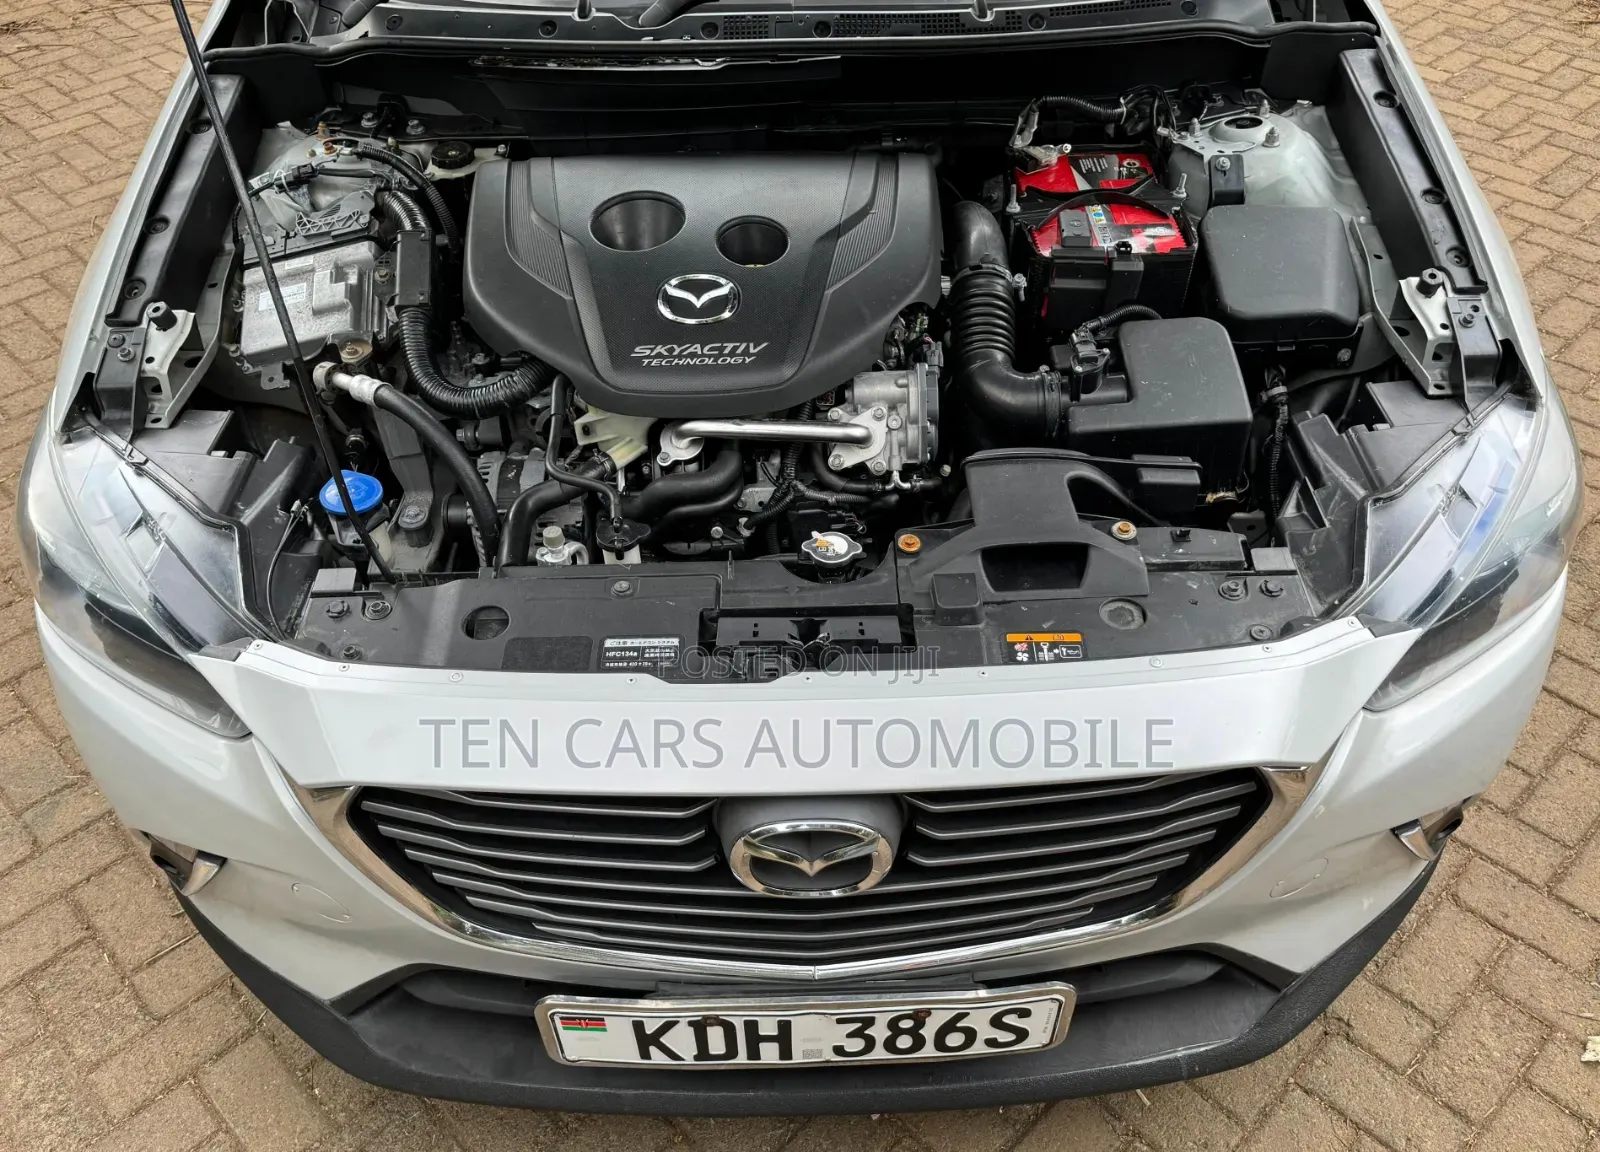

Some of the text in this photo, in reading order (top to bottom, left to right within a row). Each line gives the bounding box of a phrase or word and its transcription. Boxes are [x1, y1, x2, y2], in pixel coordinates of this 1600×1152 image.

[630, 342, 769, 357] SKYACTIV
[641, 356, 756, 367] TECHNOLOGY
[630, 1016, 793, 1062] KDH
[831, 1007, 1032, 1058] 386S
